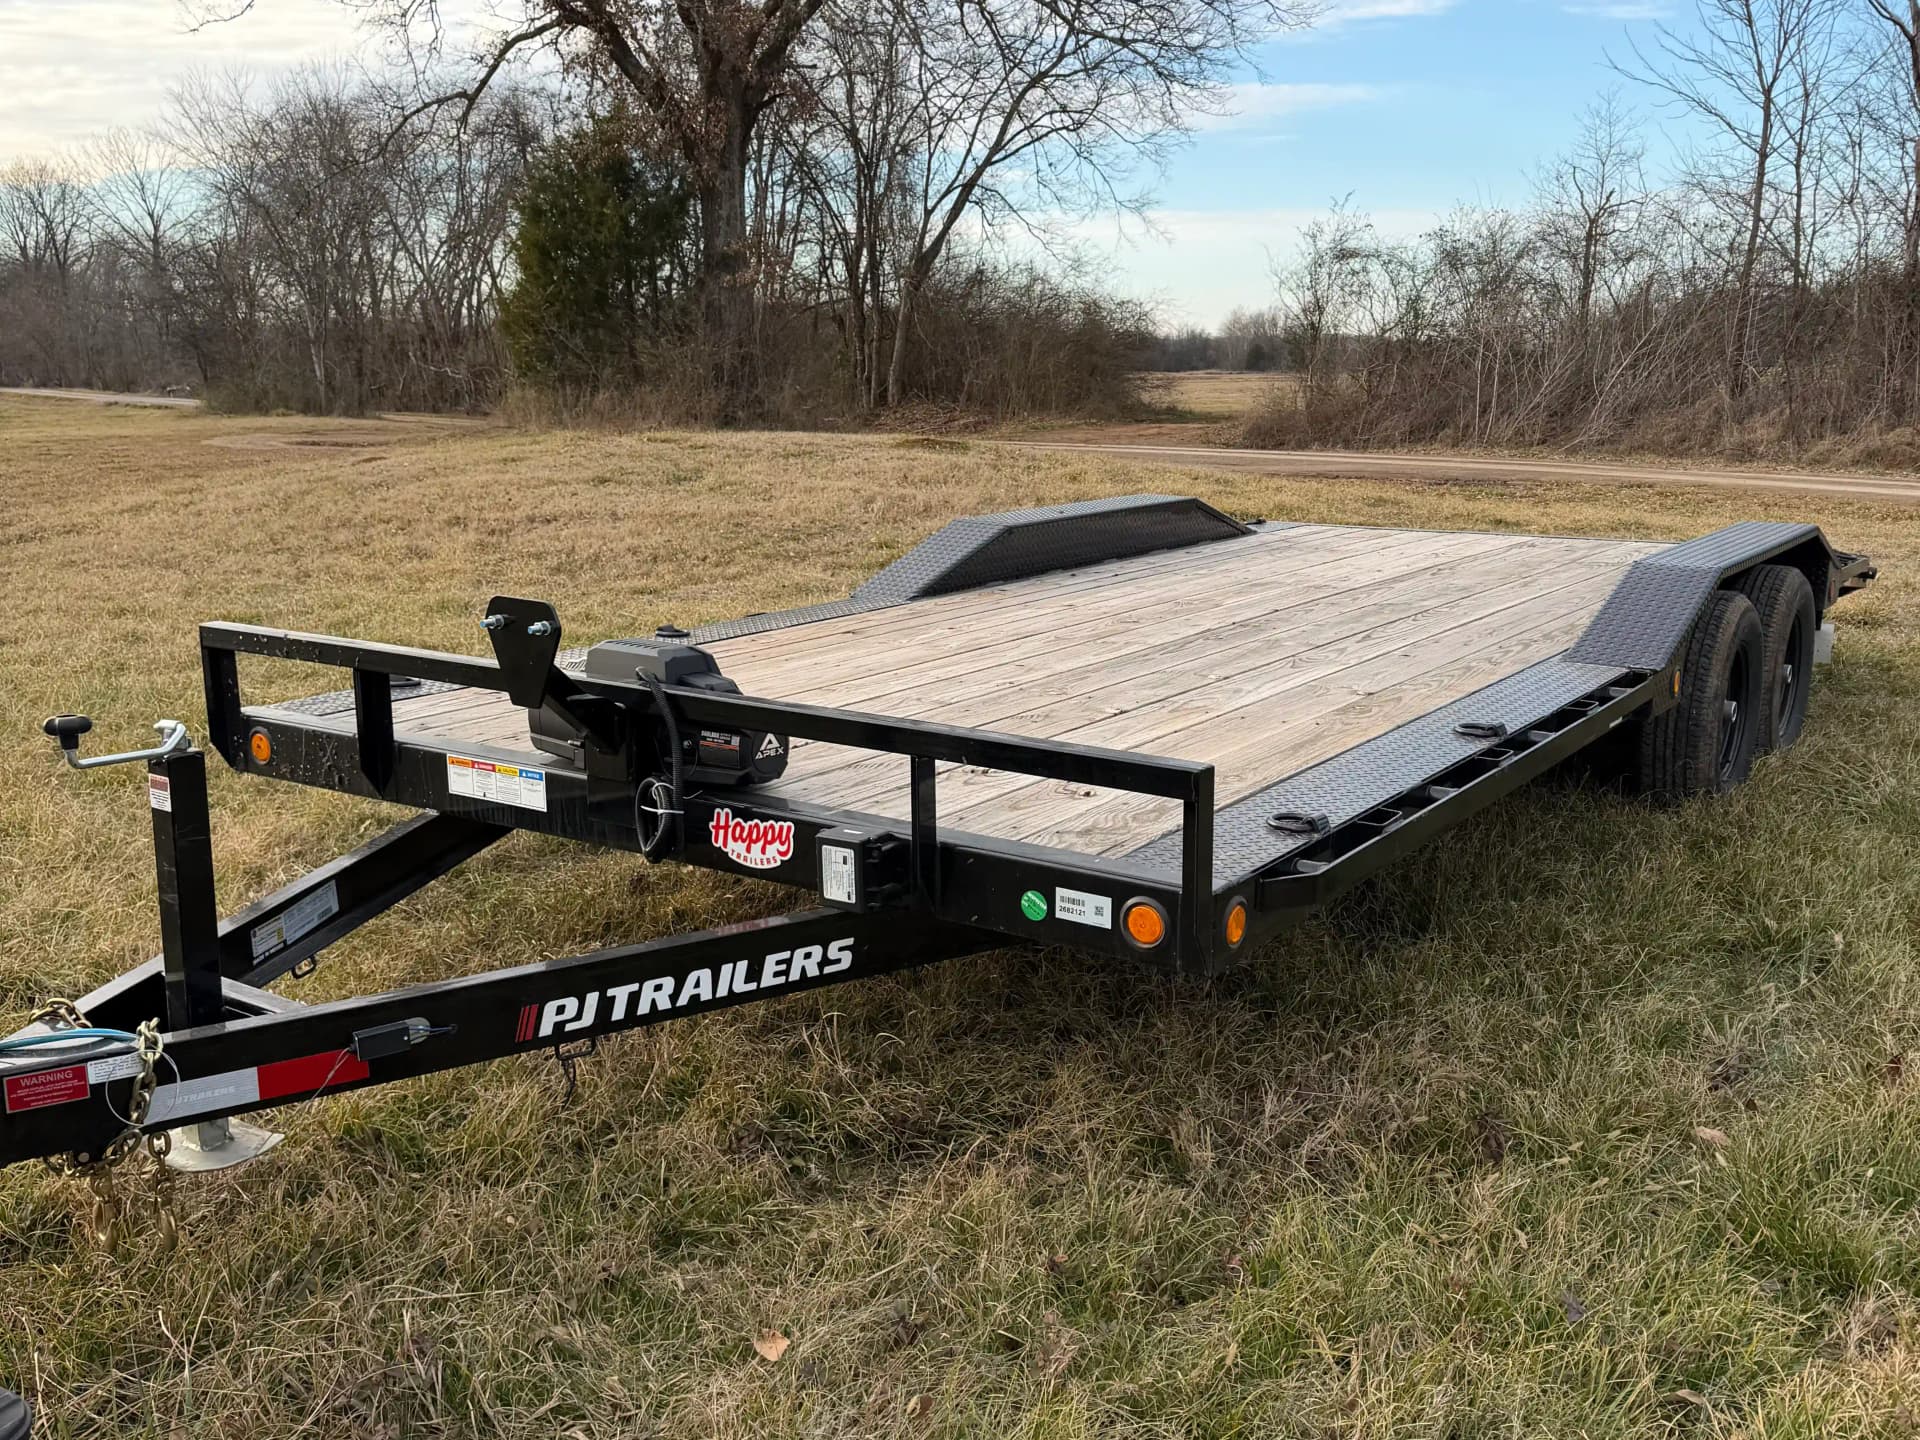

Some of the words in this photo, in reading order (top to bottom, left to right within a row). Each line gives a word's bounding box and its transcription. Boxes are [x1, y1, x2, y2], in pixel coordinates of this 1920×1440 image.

[755, 746, 785, 760] APEX
[711, 810, 792, 858] Happy
[730, 848, 778, 866] TRAILERS
[1058, 905, 1086, 917] 2682121
[538, 991, 600, 1038] PJ
[606, 937, 855, 1022] TRAILERS
[20, 1070, 73, 1087] WARNING
